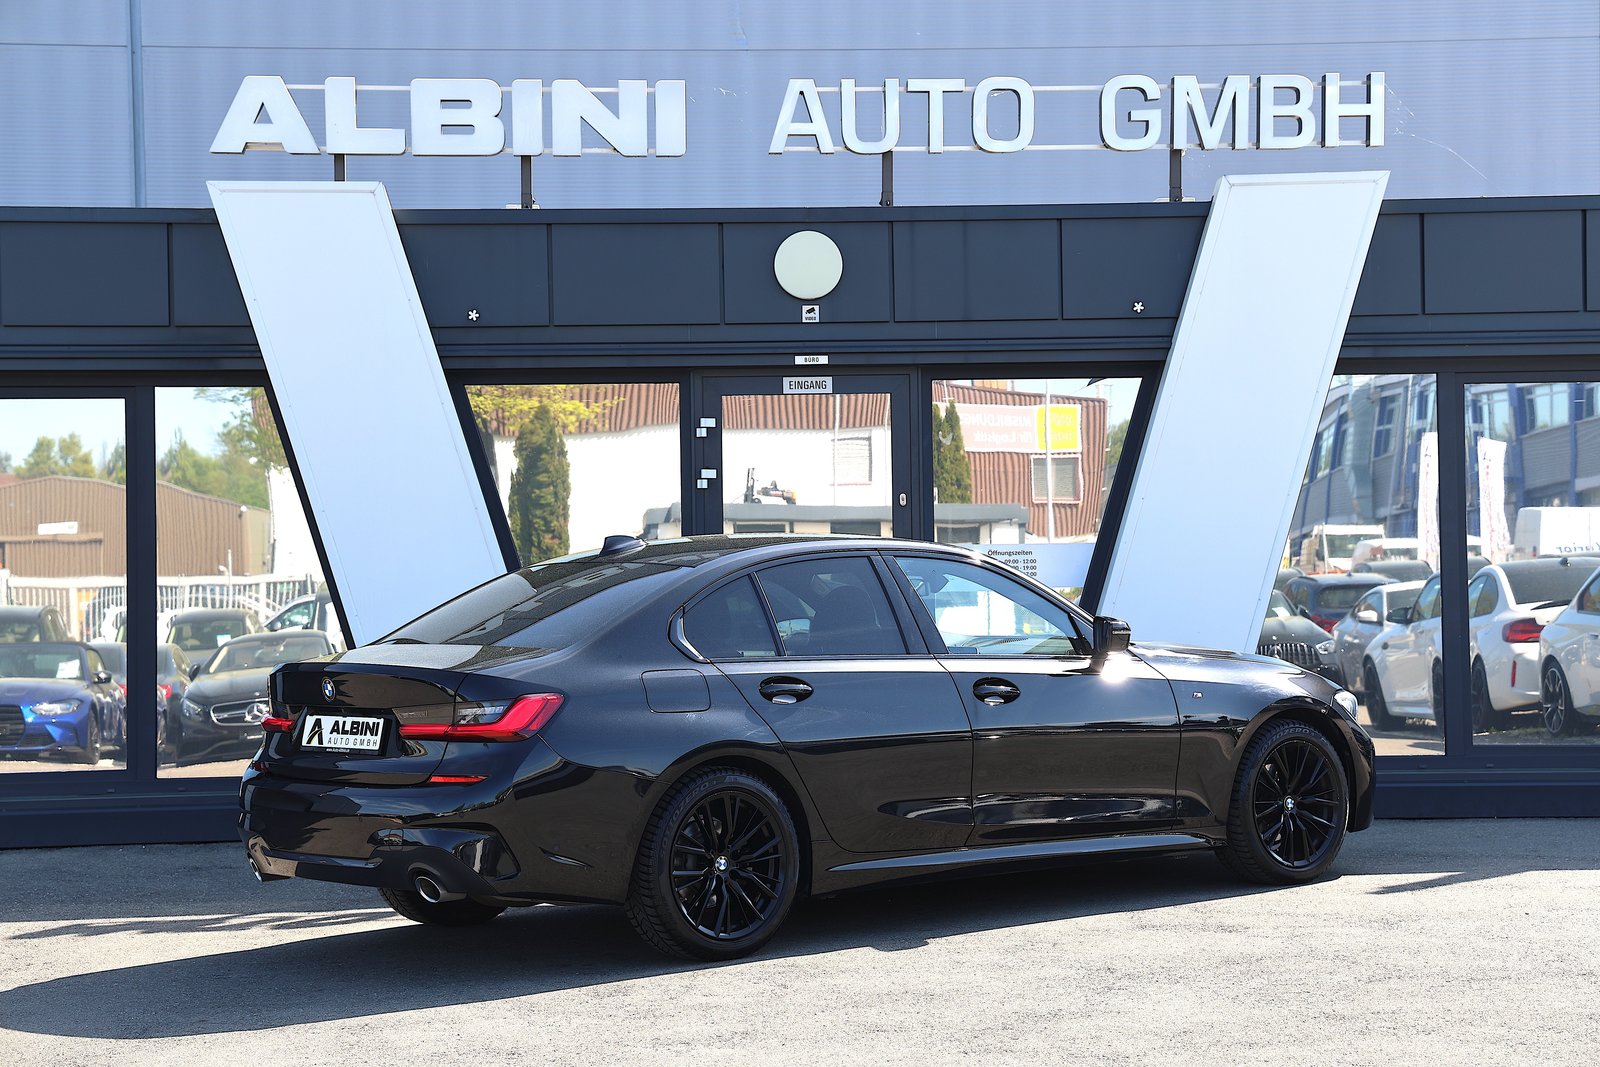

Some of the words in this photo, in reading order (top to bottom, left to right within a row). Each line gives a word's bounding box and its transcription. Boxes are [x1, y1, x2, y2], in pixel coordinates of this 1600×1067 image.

[209, 75, 687, 157] ALBINI
[768, 76, 1036, 154] AUTO
[1099, 71, 1386, 151] GMBH
[789, 380, 827, 390] EINGANG
[329, 720, 380, 736] ALBINI
[327, 737, 350, 745] AUTO
[352, 738, 378, 747] GMBH
